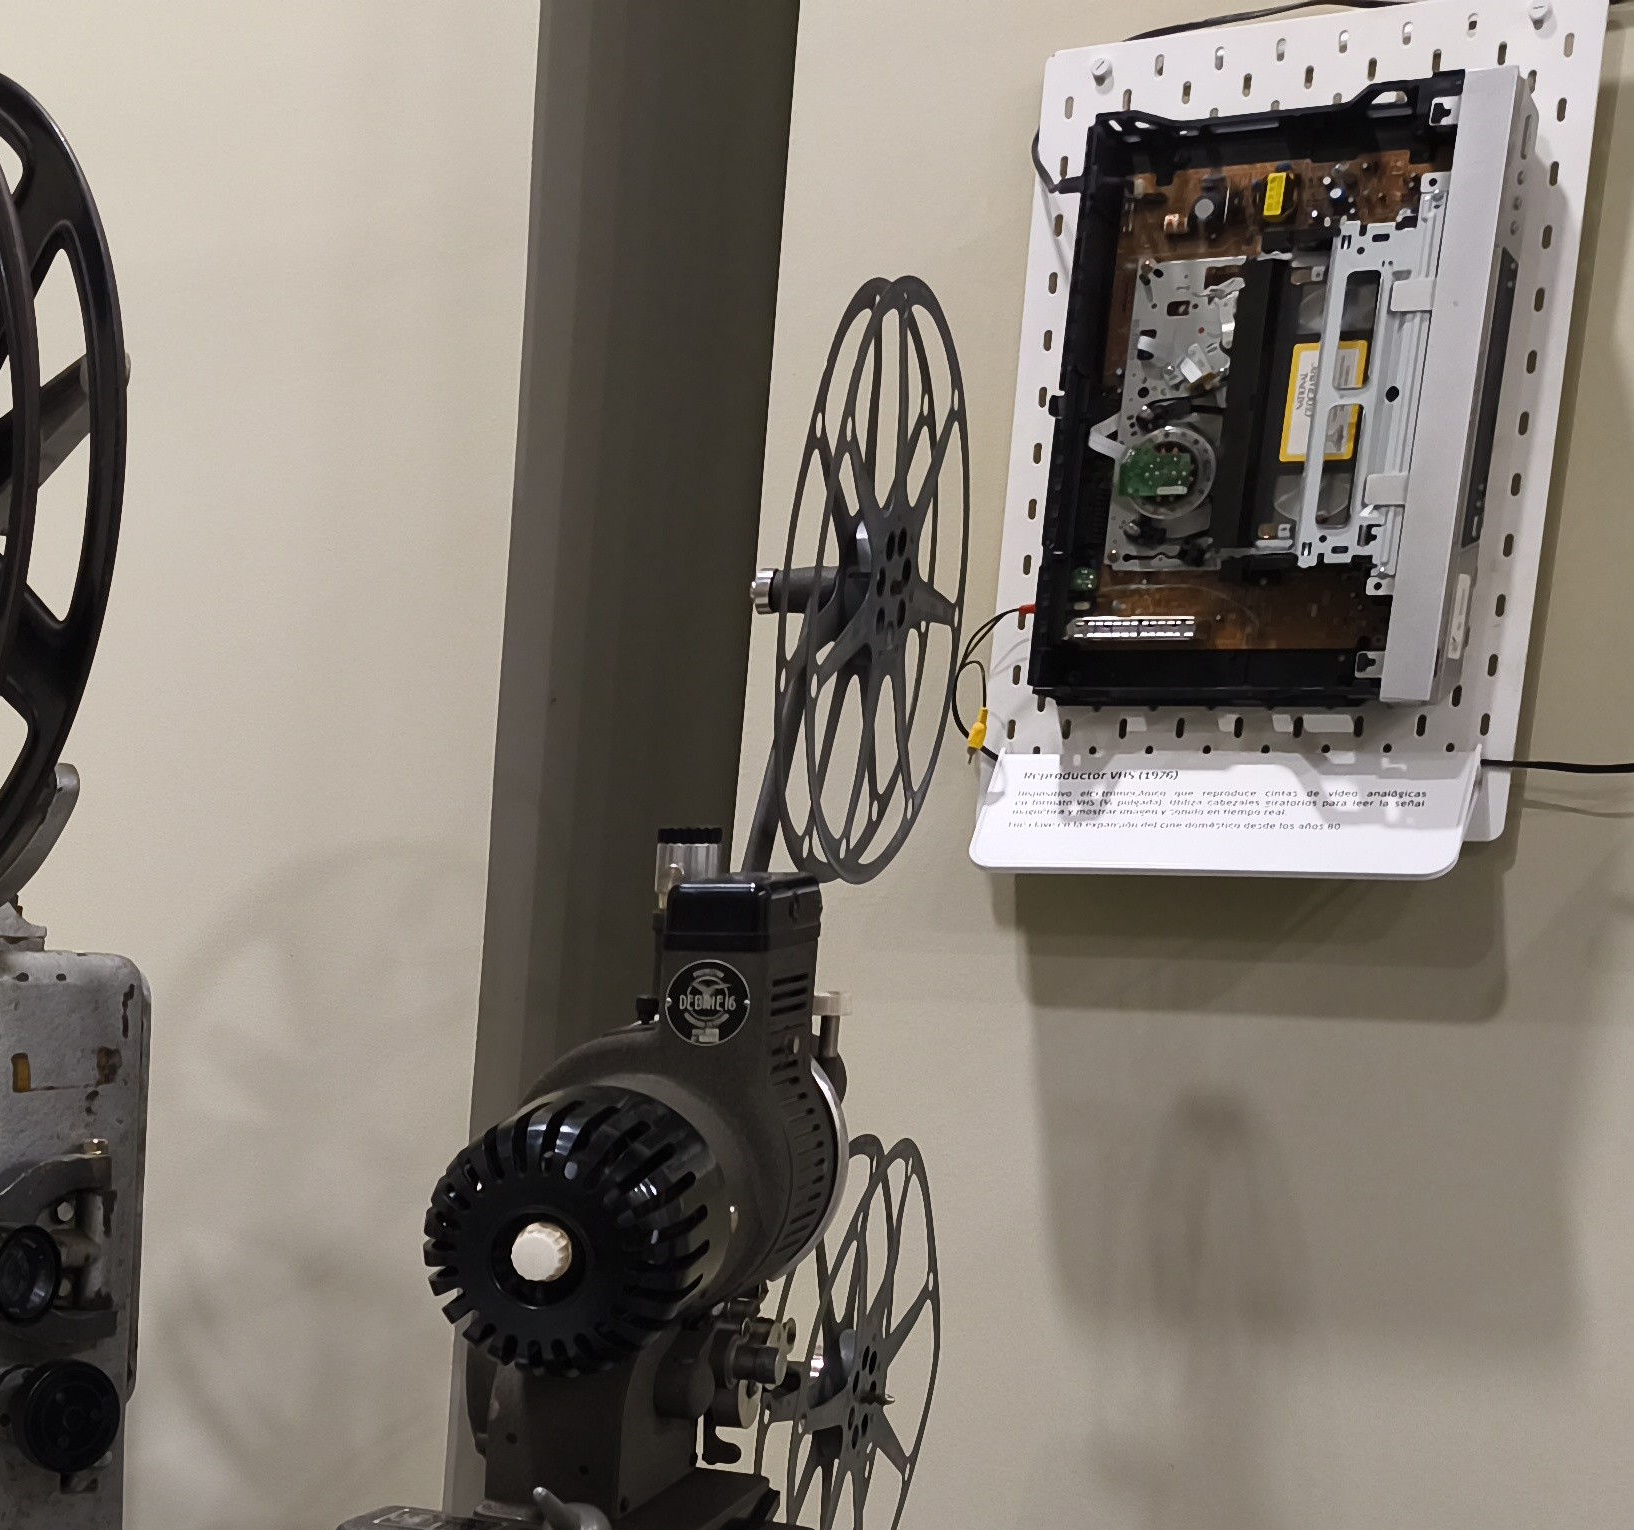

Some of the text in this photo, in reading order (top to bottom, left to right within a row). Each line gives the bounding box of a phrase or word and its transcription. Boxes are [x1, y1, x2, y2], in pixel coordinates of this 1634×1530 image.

[1023, 771, 1180, 781] Reproductor VHS (1976)
[1174, 791, 1194, 799] que
[1202, 789, 1257, 798] reproduce
[1264, 789, 1298, 798] cintas
[1306, 790, 1320, 798] de
[1366, 789, 1427, 799] analógicas
[1076, 799, 1095, 807] VHS
[1207, 799, 1261, 807] cabezales
[1264, 799, 1319, 808] giratorios
[1321, 799, 1348, 808] para
[1352, 799, 1375, 808] leer
[1379, 799, 1389, 808] la
[1395, 799, 1426, 808] señal
[1075, 808, 1117, 817] mostrar
[1206, 809, 1220, 817] en
[1223, 809, 1261, 818] tiempo
[1244, 821, 1277, 830] desde
[1279, 821, 1295, 830] los
[1298, 822, 1325, 830] años
